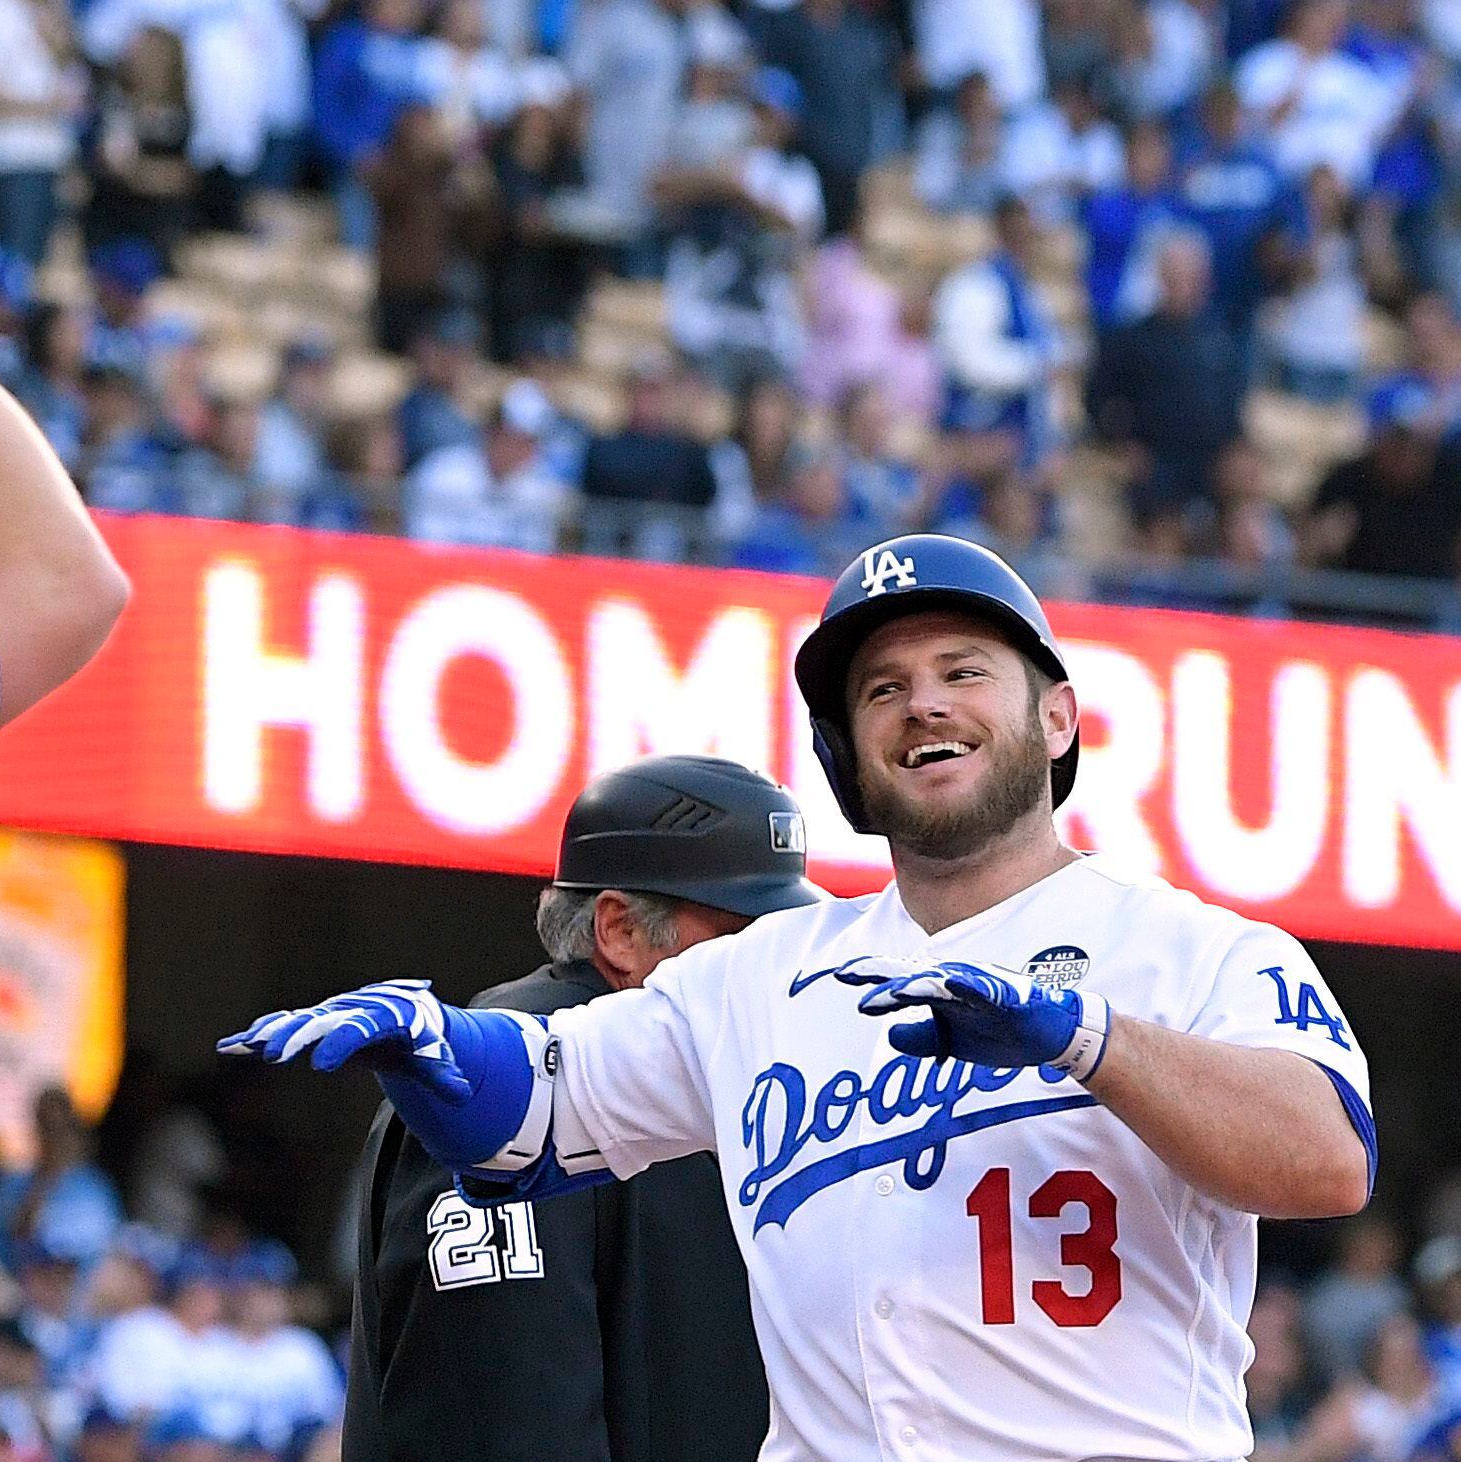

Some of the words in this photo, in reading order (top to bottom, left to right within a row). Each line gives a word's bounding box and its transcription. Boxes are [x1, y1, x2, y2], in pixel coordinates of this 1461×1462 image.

[860, 546, 918, 598] LA
[1035, 971, 1082, 984] EHRIG
[1052, 961, 1087, 973] LOU
[1256, 966, 1352, 1052] LA
[426, 1189, 545, 1292] 21
[966, 1167, 1122, 1328] 13
